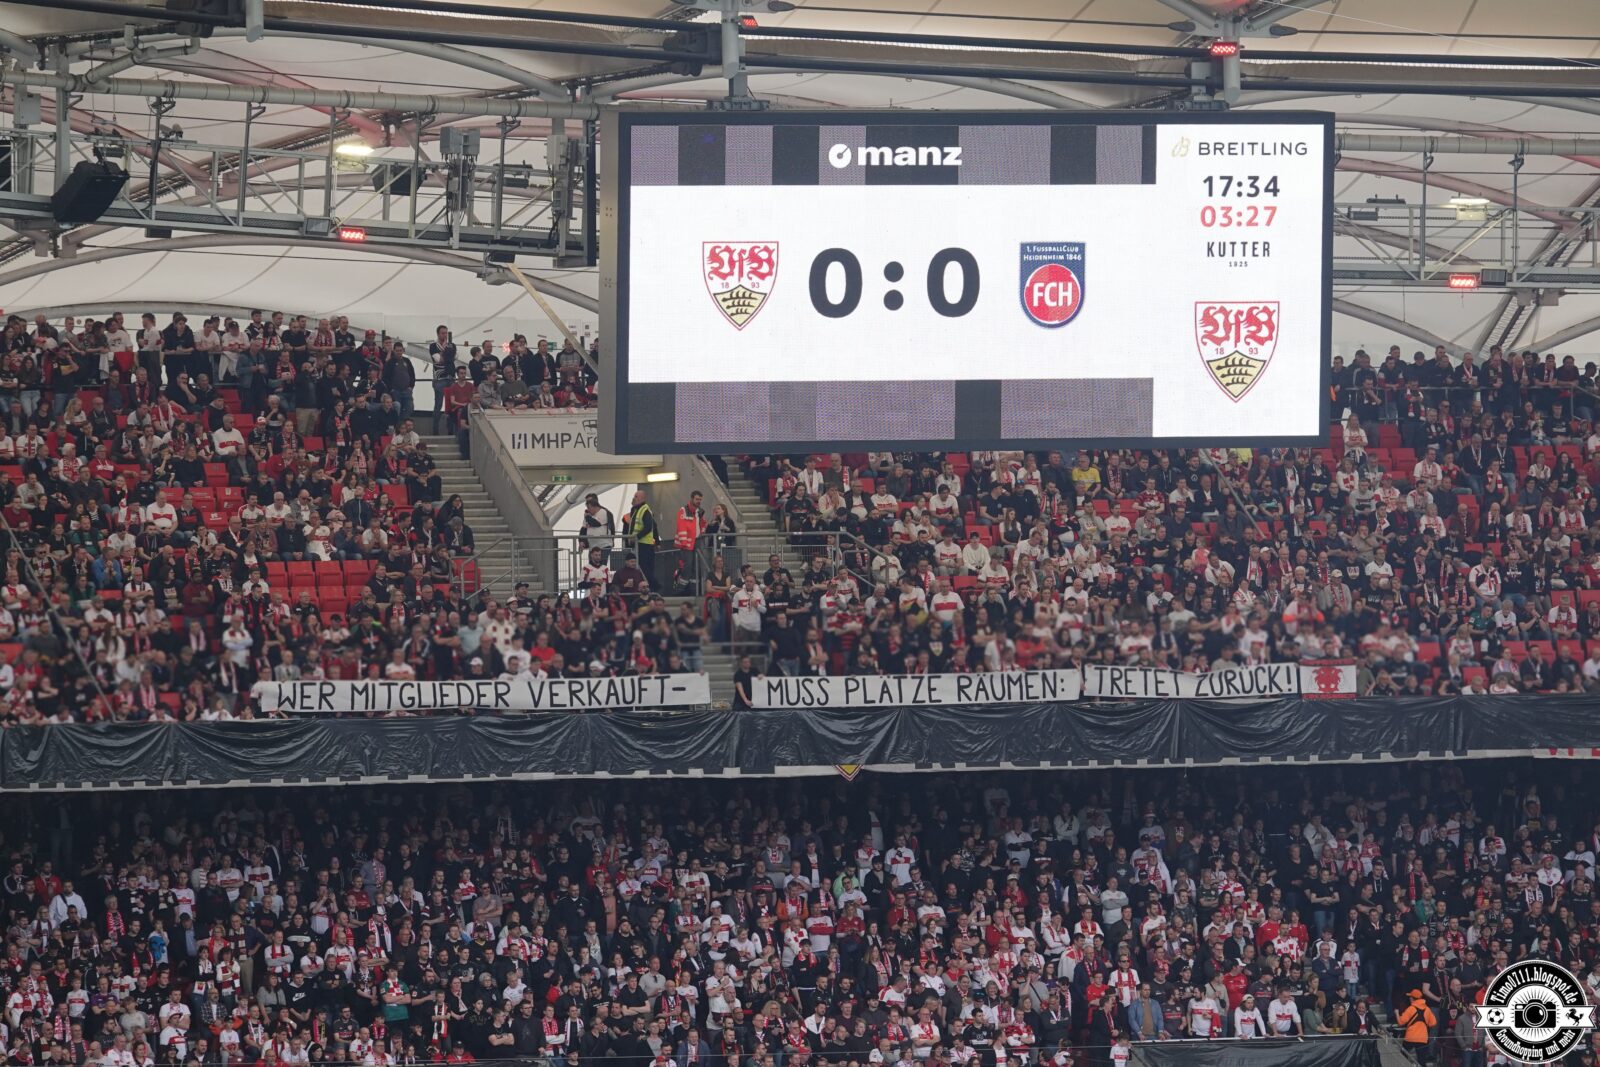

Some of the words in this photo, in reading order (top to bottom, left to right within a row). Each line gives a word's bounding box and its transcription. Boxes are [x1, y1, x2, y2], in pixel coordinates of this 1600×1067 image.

[857, 146, 963, 166] manz
[1198, 142, 1308, 156] BREITLING
[1202, 175, 1281, 198] 17:34
[1200, 205, 1278, 228] 03:27
[1206, 241, 1271, 258] KUTTER
[1032, 281, 1073, 307] FCH
[1214, 347, 1225, 355] 18
[1248, 347, 1259, 355] 93
[767, 677, 830, 706] MUSS
[845, 675, 943, 704] PLÄTZE
[957, 671, 1066, 702] RÄUMEN:
[1093, 665, 1185, 696] TRETET
[1194, 664, 1293, 697] ZURÜCK!
[277, 682, 336, 710] WER
[350, 681, 511, 710] MITGLIEDER
